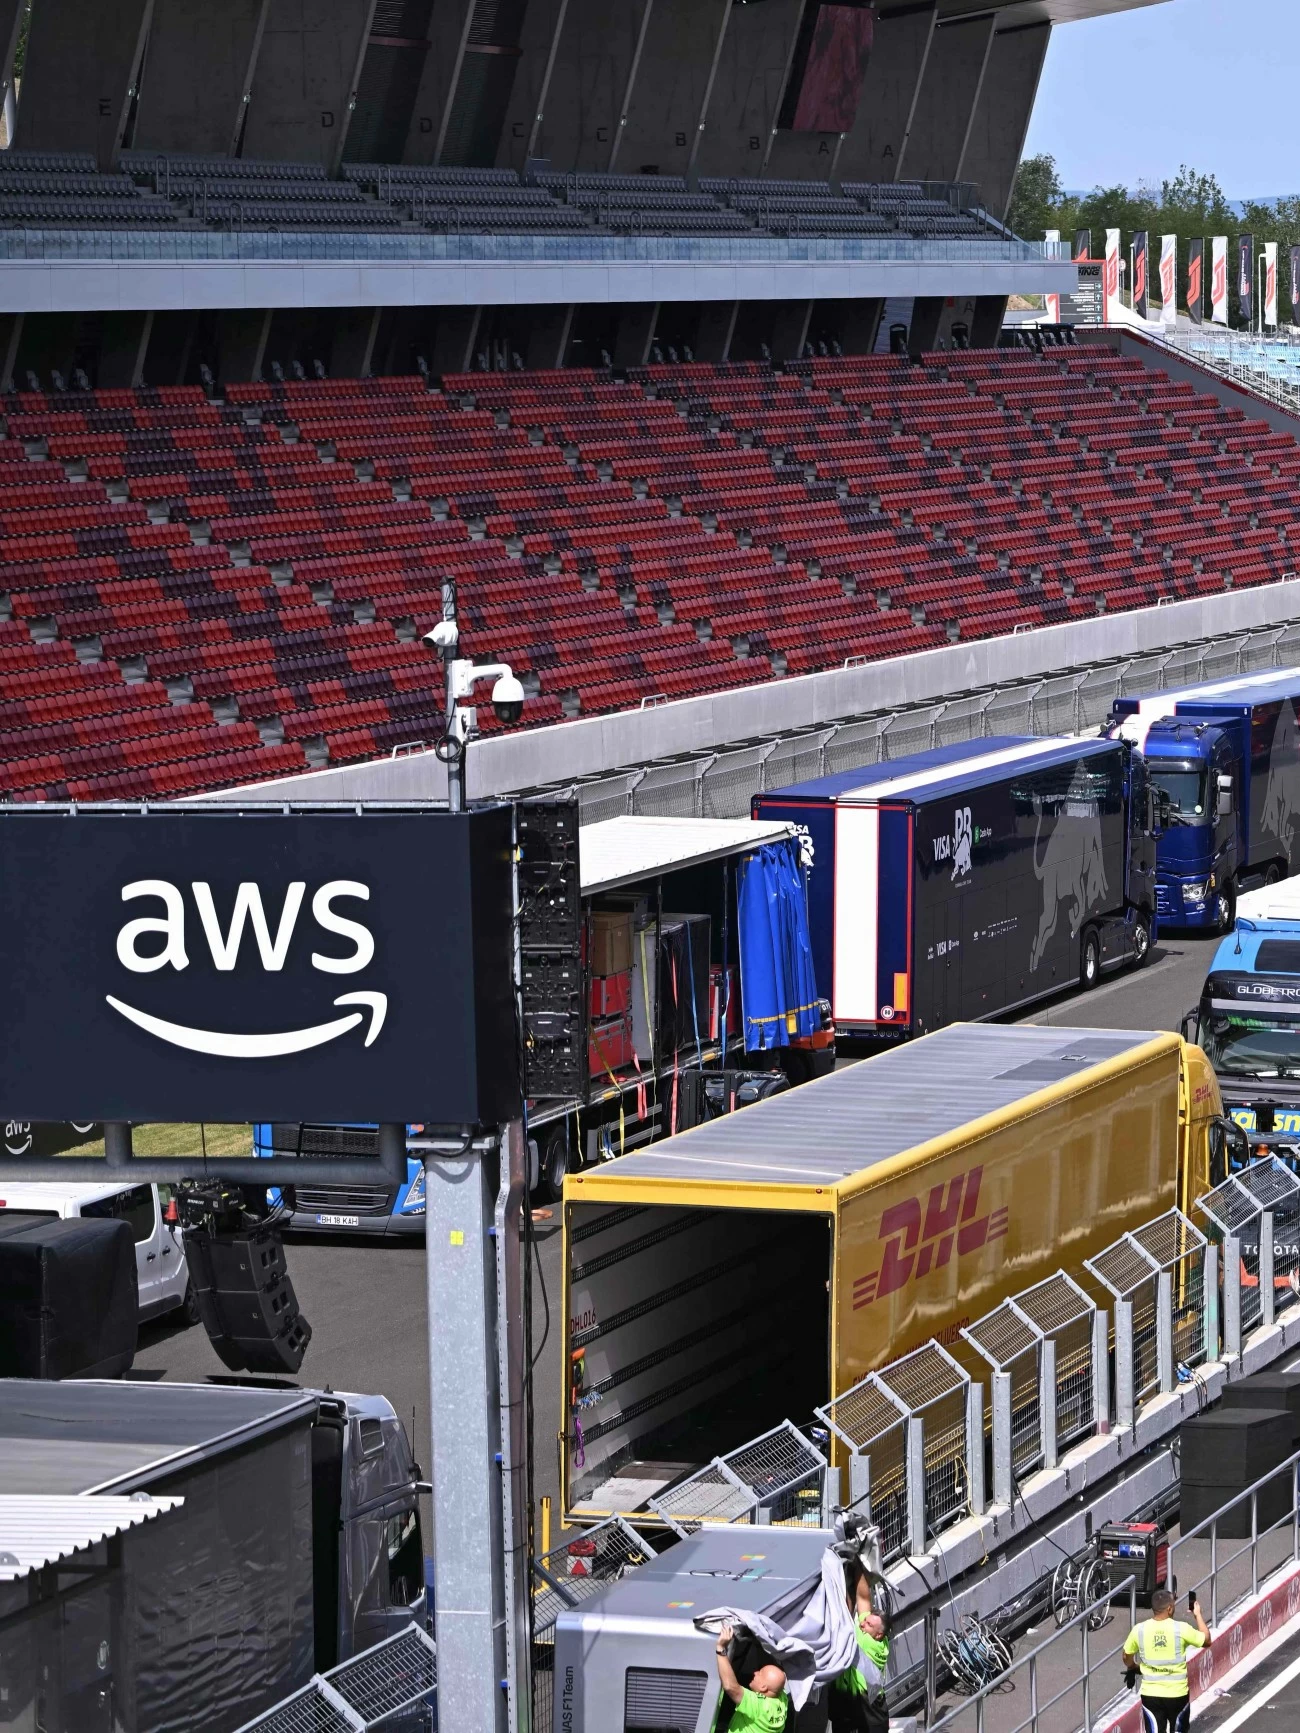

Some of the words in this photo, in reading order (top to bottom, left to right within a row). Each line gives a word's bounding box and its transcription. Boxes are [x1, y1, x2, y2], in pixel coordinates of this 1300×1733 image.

[99, 99, 111, 116] E
[321, 111, 334, 128] D
[420, 118, 432, 133] D
[512, 123, 525, 138] C
[597, 128, 608, 142] C
[676, 132, 687, 146] B
[750, 137, 760, 150] B
[818, 142, 829, 155] A
[882, 145, 894, 158] A
[963, 301, 974, 313] A
[793, 824, 809, 835] ISA
[932, 834, 951, 862] VISA
[116, 880, 374, 974] aws
[936, 940, 947, 957] VISA
[1195, 1083, 1211, 1103] DHL
[321, 1215, 332, 1224] BH
[342, 1217, 358, 1225] KAH
[875, 1164, 989, 1300] DHL
[1243, 1244, 1299, 1255] TOOTA
[570, 1307, 596, 1335] DHL016
[562, 1665, 574, 1697] Team
[562, 1697, 573, 1711] F1
